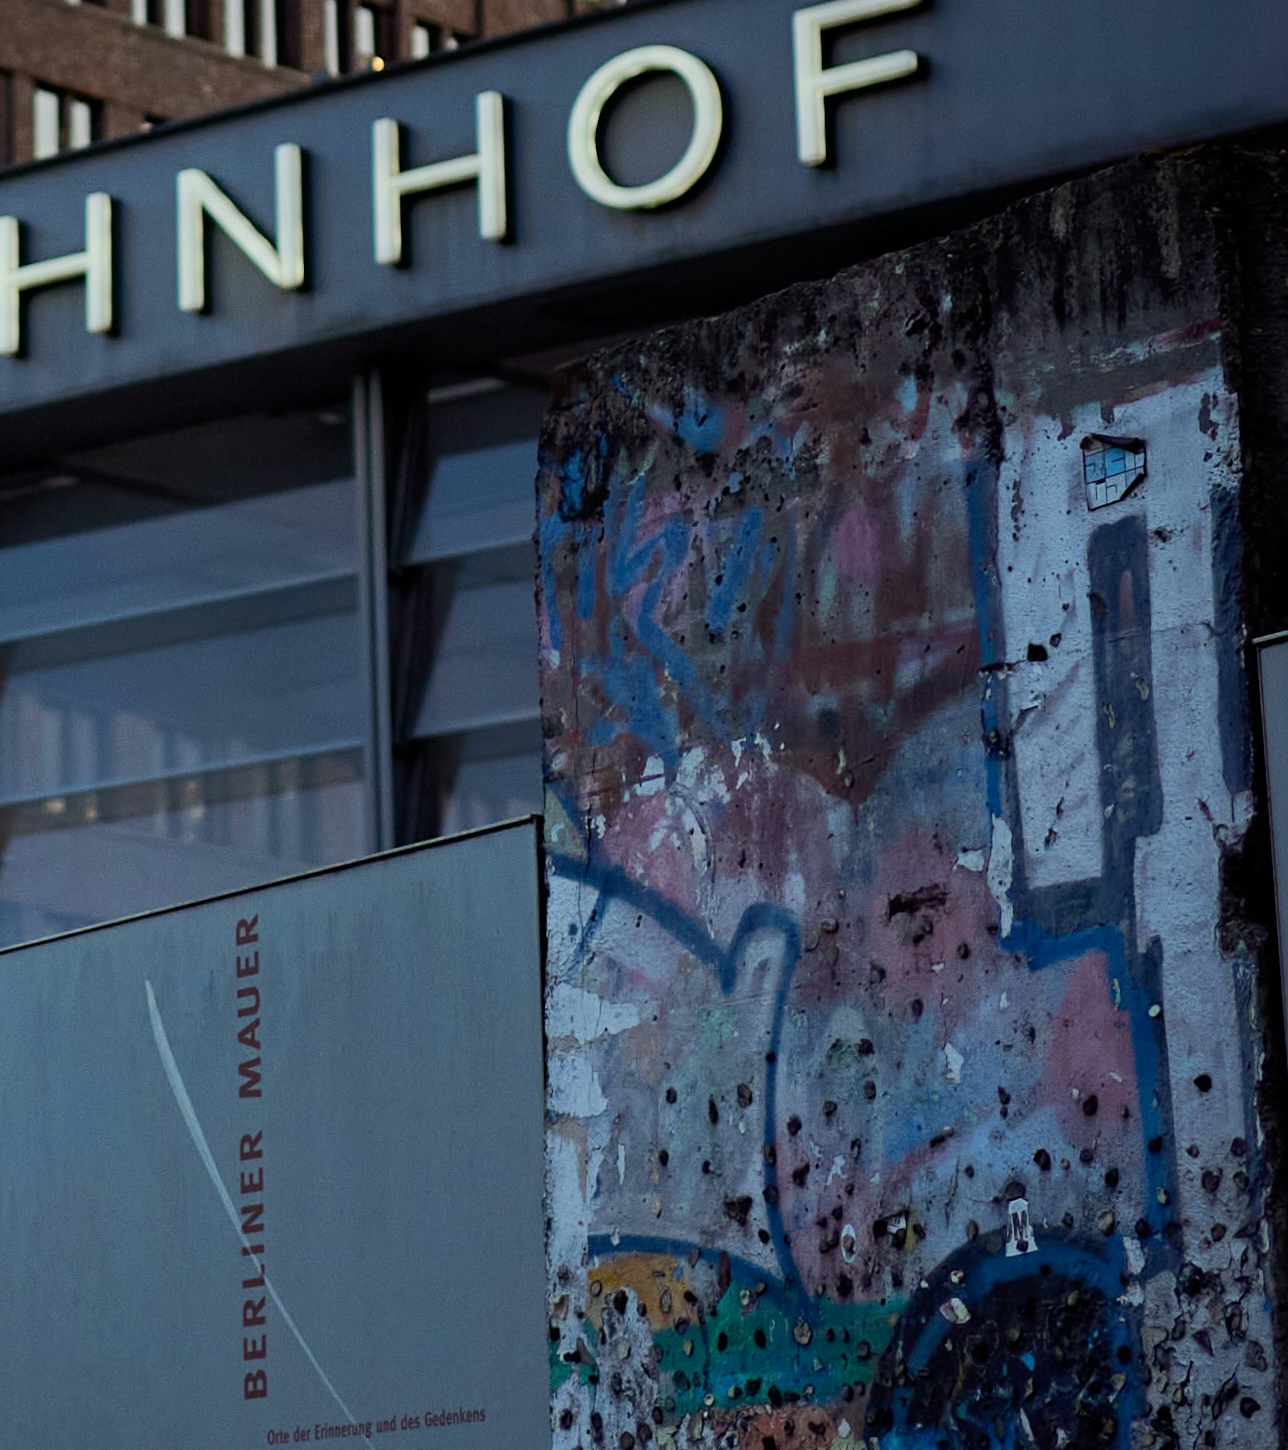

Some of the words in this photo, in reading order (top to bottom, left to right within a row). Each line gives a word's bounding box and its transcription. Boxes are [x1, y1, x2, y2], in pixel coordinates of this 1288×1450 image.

[236, 913, 263, 1098] MAUER
[239, 1131, 268, 1400] BERLINER
[267, 1428, 289, 1446] Orte
[293, 1425, 311, 1443] der
[314, 1420, 373, 1439] Erinnerung
[375, 1415, 397, 1433] und
[400, 1413, 421, 1431] des
[424, 1406, 487, 1428] Gedenkens
